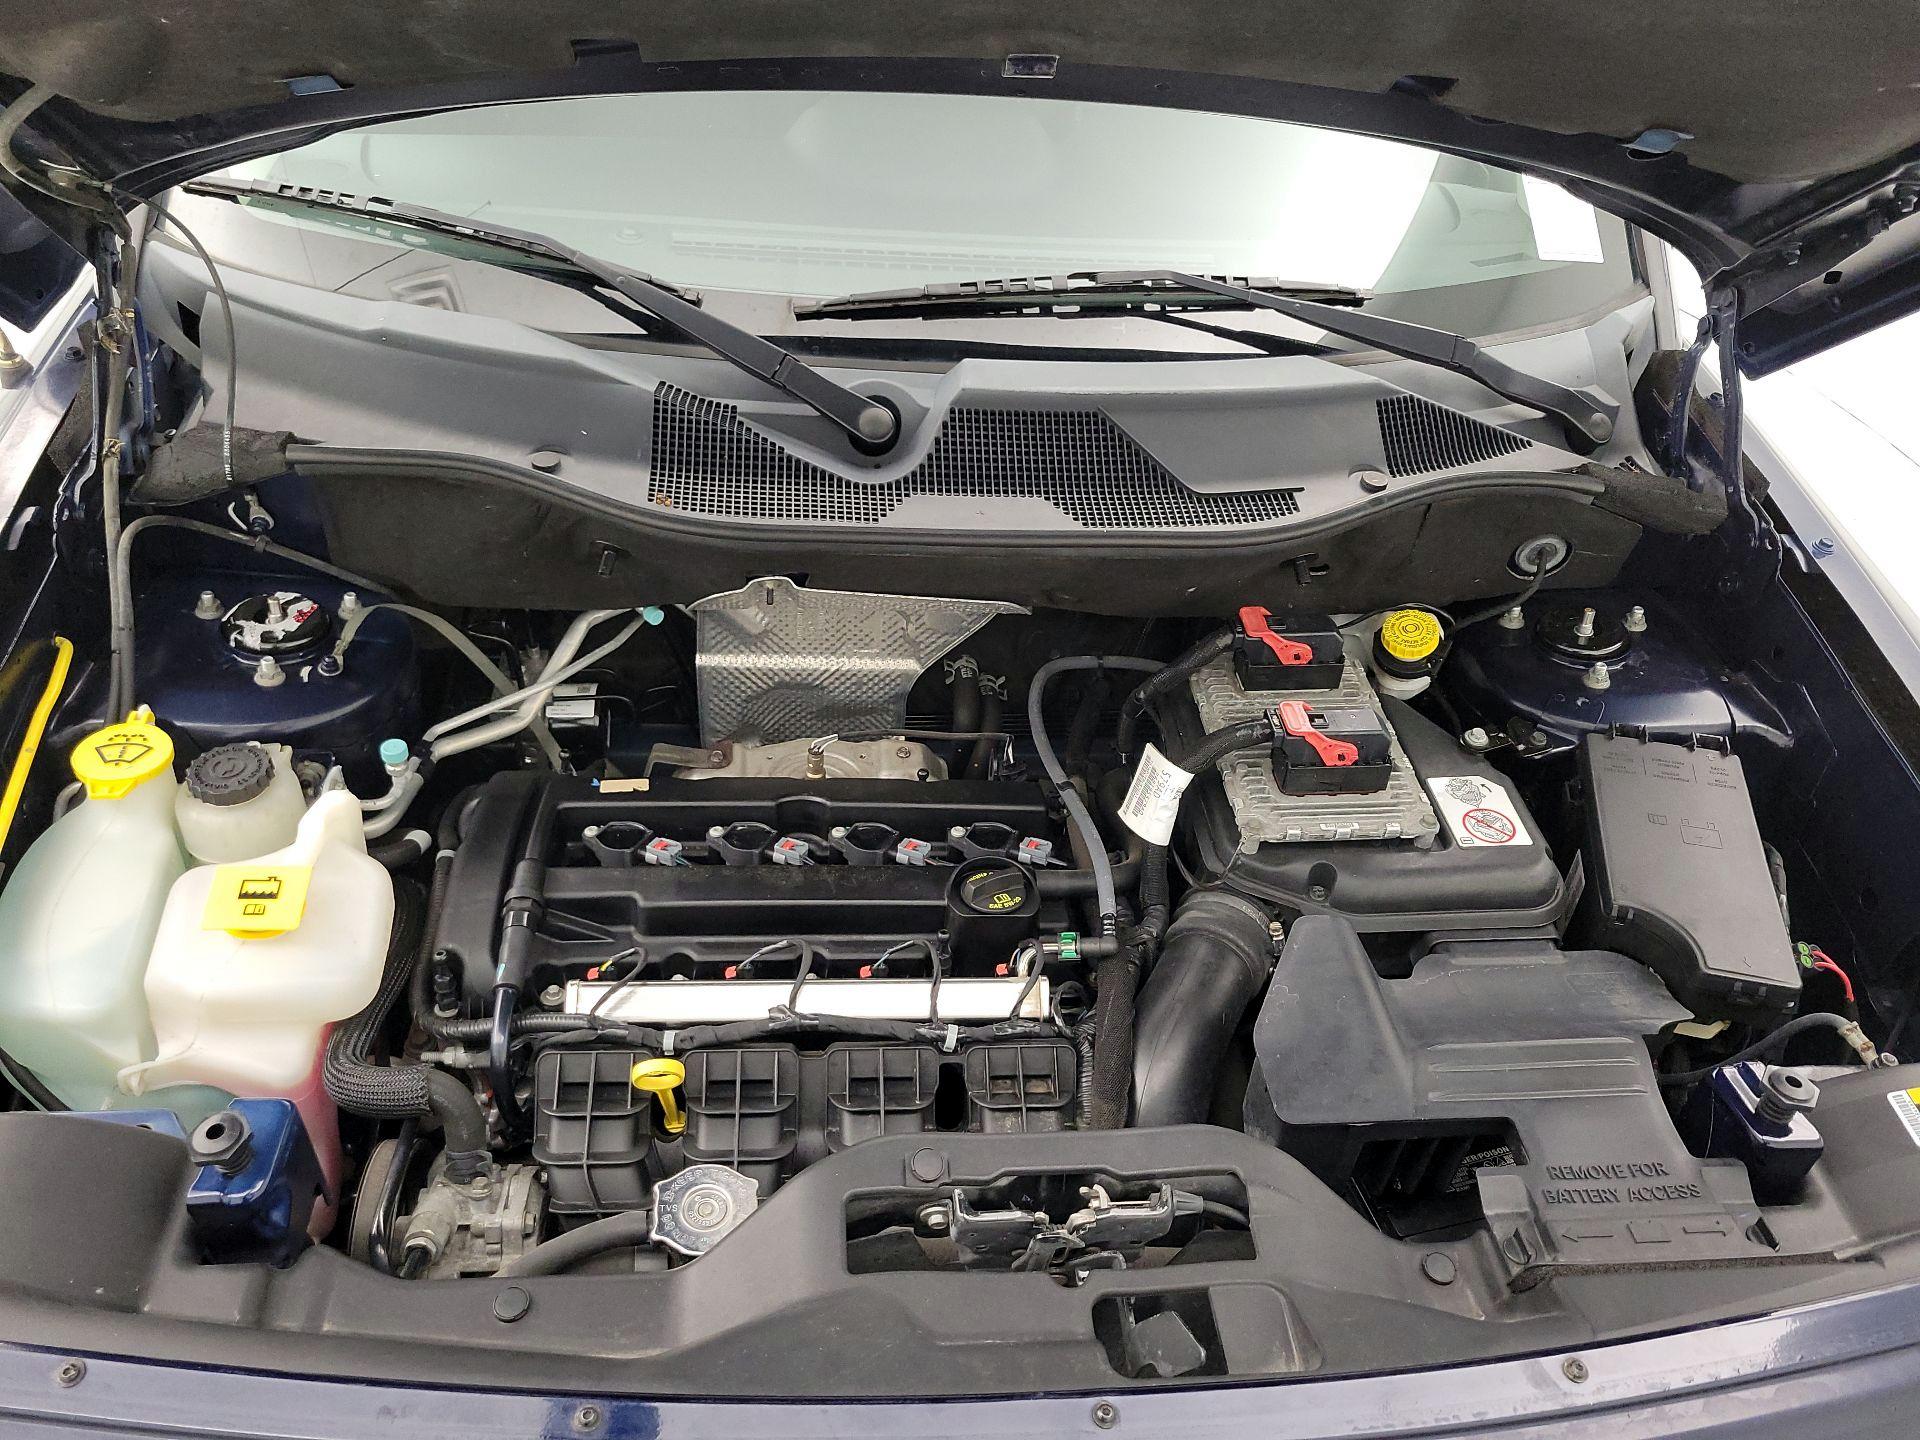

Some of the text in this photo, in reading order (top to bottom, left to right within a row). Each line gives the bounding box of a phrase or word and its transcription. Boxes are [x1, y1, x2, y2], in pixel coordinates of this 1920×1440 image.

[1546, 1161, 1670, 1180] REMOVE FOR
[1542, 1183, 1702, 1204] BATTERY ACCESS
[659, 1204, 678, 1212] TVS
